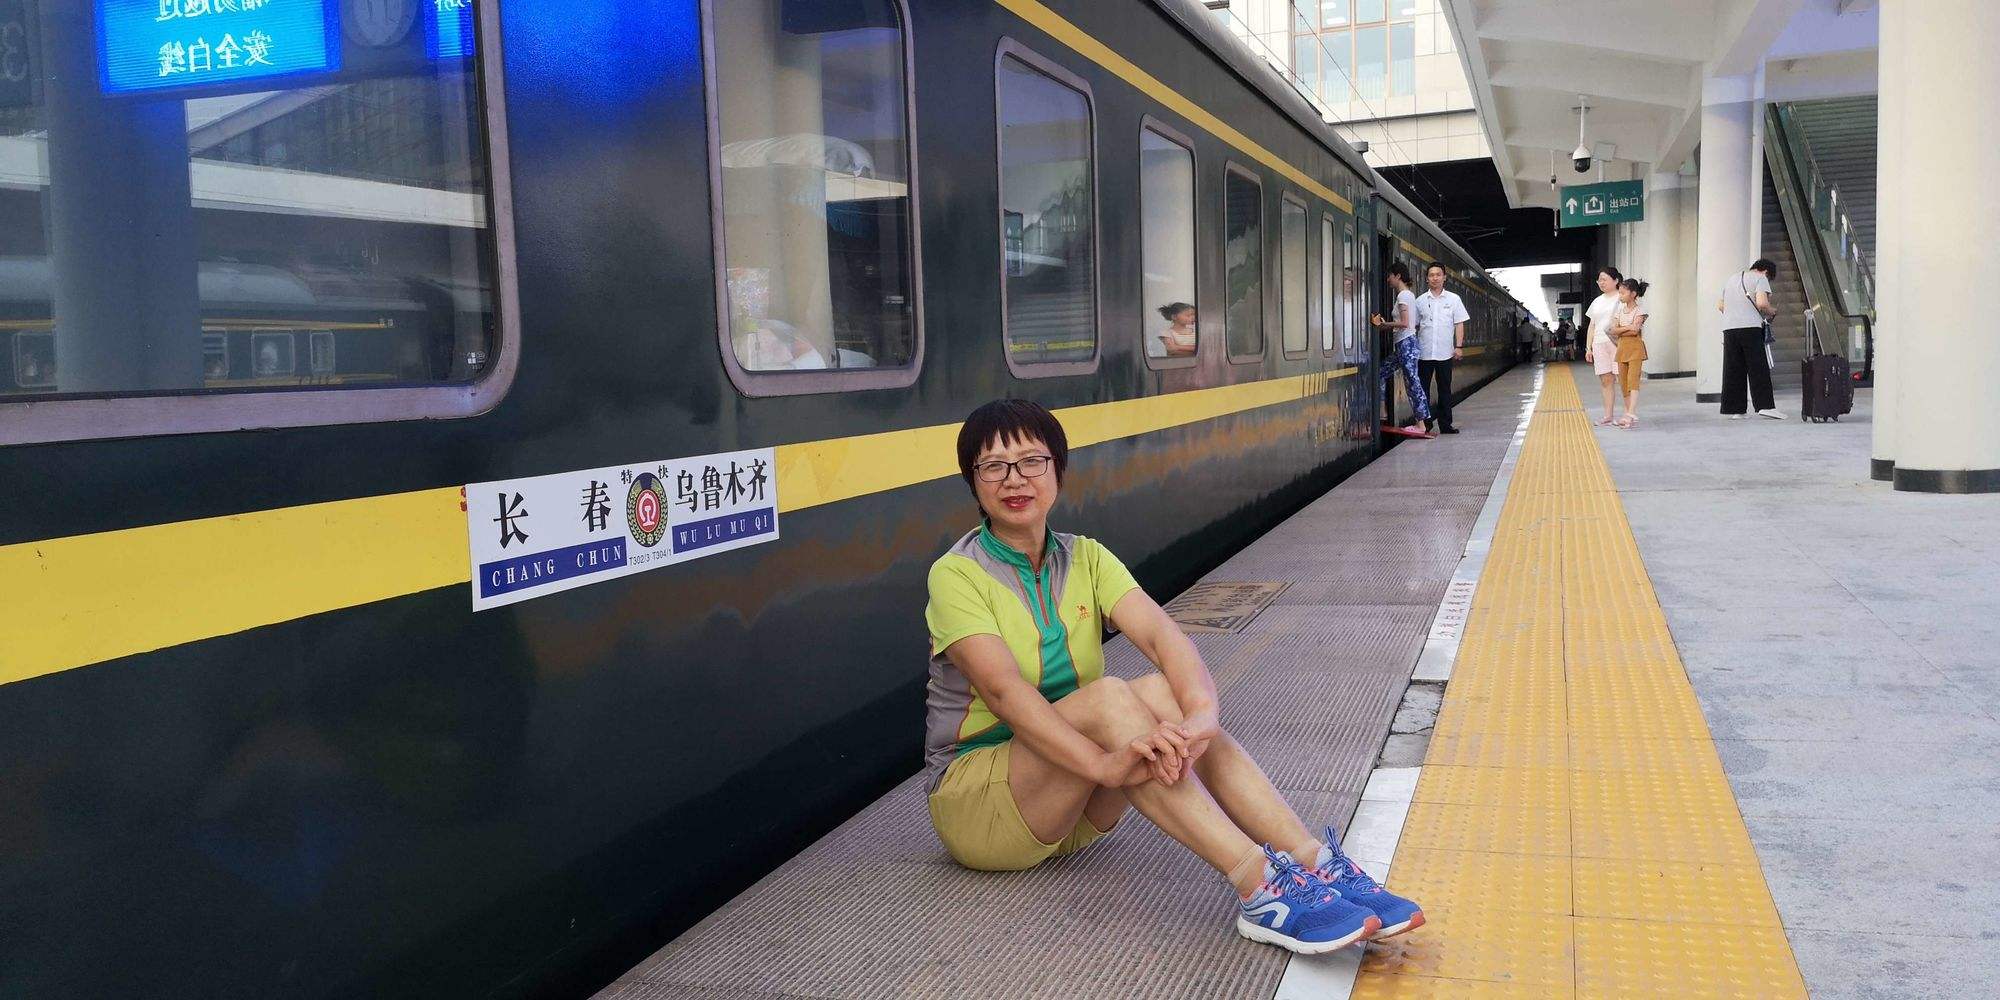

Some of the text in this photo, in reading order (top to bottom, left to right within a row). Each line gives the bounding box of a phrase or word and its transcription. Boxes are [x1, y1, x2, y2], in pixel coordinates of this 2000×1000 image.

[1609, 197, 1639, 208] 出站口
[674, 457, 768, 513] 乌鲁木齐
[680, 515, 767, 546] WU LU MU QI
[492, 545, 621, 587] CHANG CHUN
